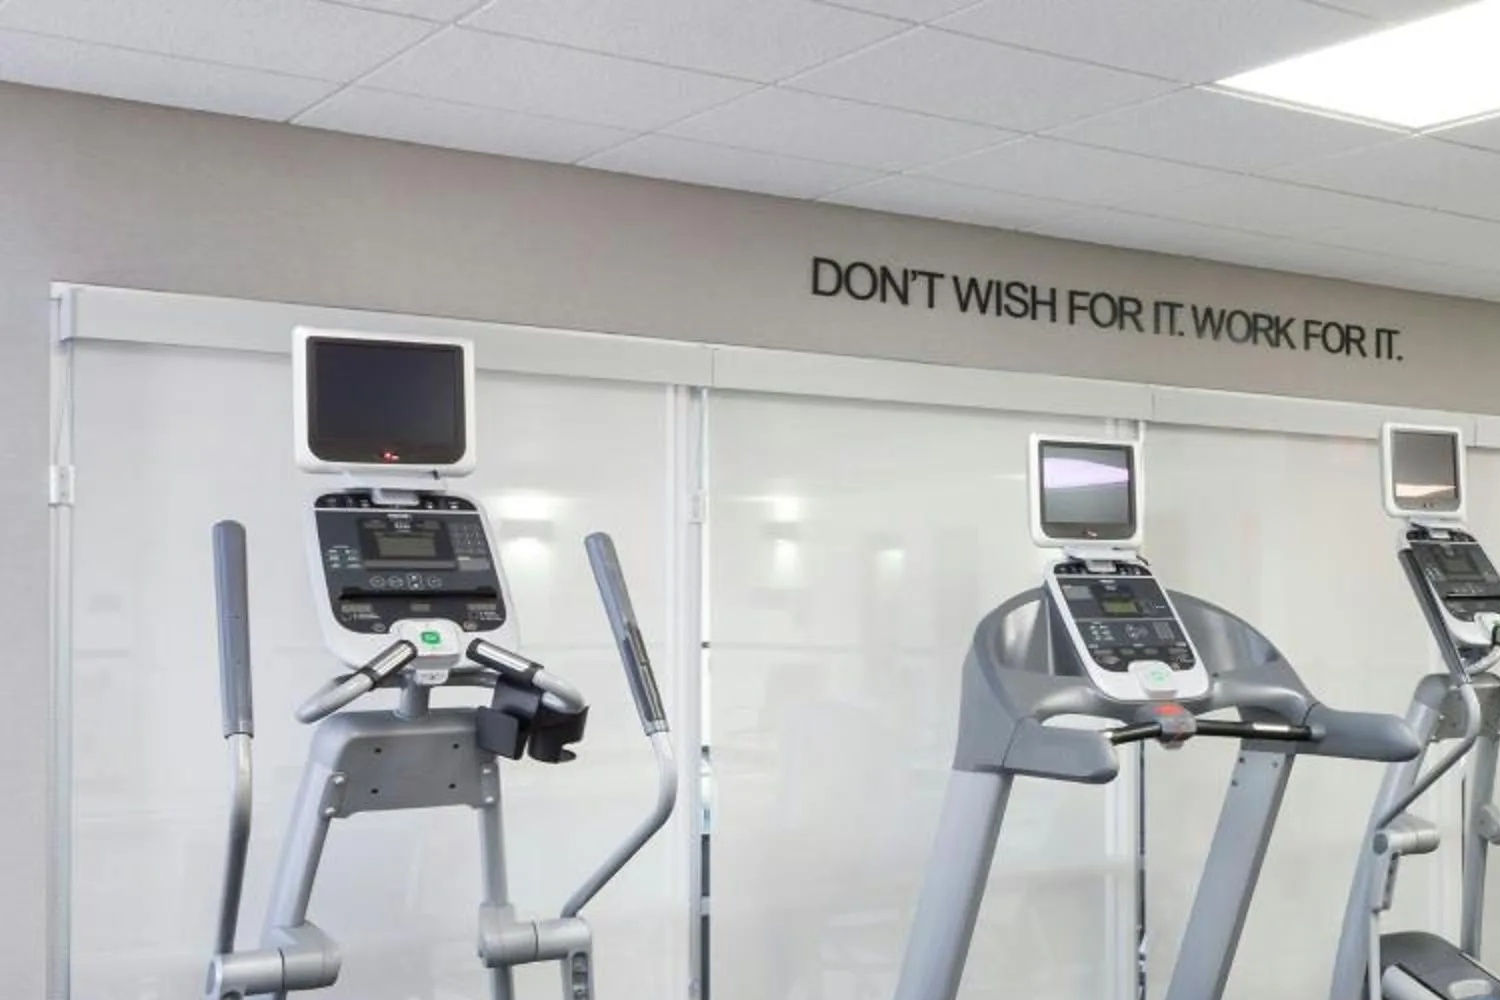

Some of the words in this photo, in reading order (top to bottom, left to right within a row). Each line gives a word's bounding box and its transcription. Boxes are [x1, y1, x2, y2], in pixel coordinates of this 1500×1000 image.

[811, 255, 946, 309] DON'T
[951, 274, 1057, 323] WISH
[1067, 289, 1145, 333] FOR
[1152, 300, 1185, 337] IT.
[1190, 303, 1297, 350] WORK
[1303, 319, 1368, 358] FOR
[1374, 327, 1403, 361] IT.
